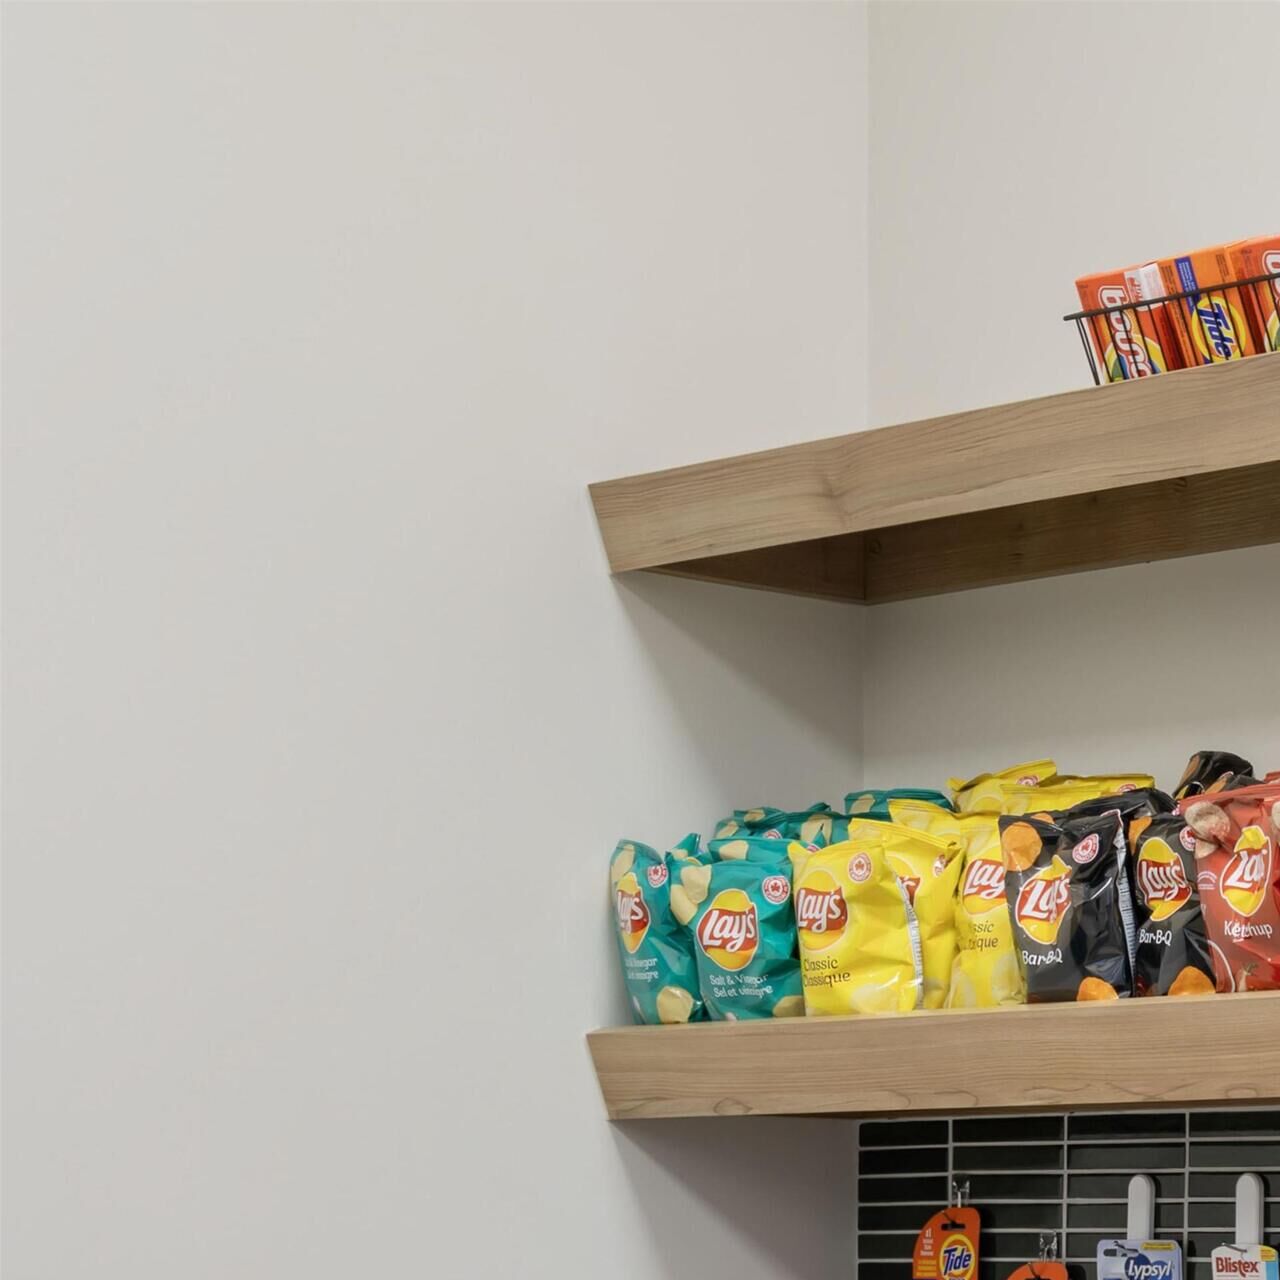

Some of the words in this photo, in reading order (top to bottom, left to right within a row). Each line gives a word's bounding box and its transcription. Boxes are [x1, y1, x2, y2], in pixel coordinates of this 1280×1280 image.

[1198, 302, 1235, 361] Tide
[1142, 860, 1187, 902] Lay's
[703, 909, 756, 952] Lay's
[799, 888, 842, 933] Lay's
[1224, 919, 1273, 938] Ketchup
[943, 1246, 972, 1276] Tide
[1216, 1257, 1260, 1277] Blistex
